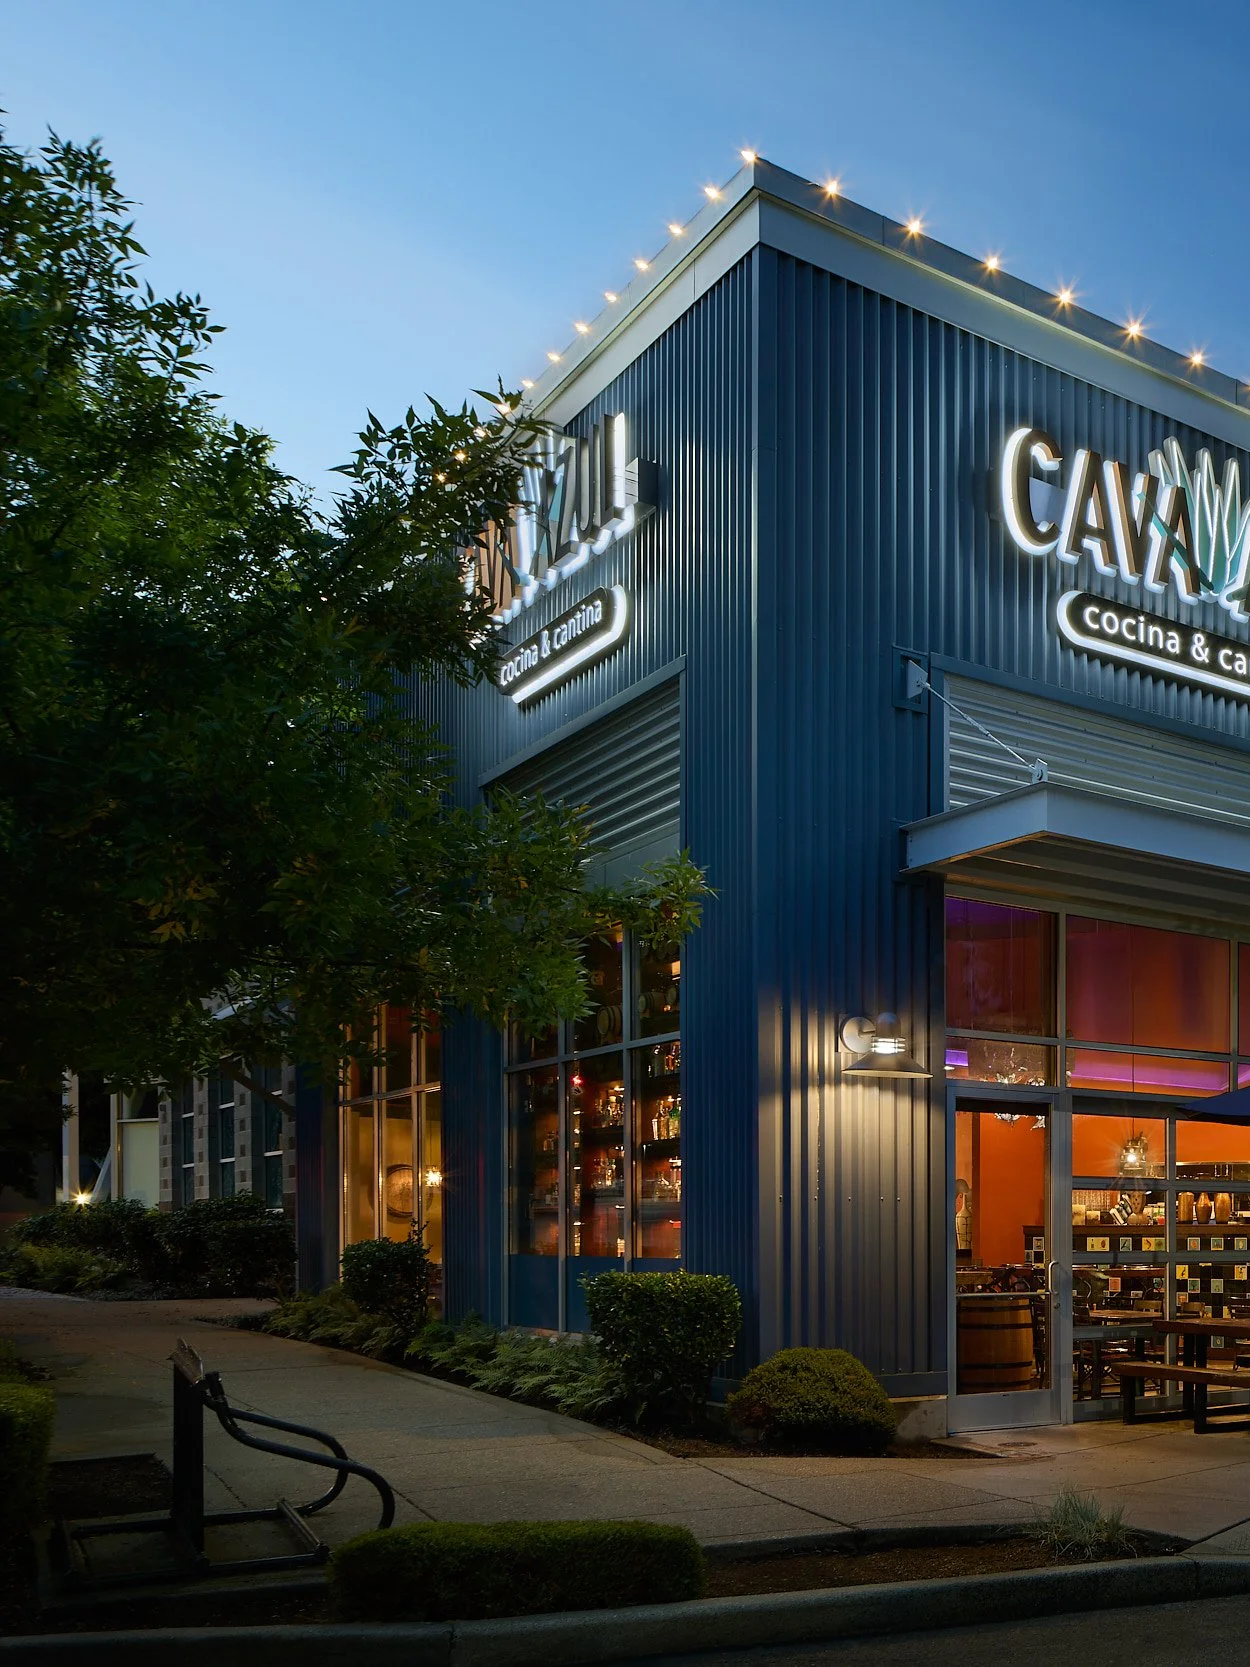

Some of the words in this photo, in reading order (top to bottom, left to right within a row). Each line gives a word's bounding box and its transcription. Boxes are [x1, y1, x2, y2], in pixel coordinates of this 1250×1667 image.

[1002, 427, 1203, 605] CAVA
[500, 643, 538, 686] cocina
[541, 629, 551, 659] &
[552, 600, 602, 650] cantina
[1082, 603, 1181, 655] cocina
[1189, 632, 1210, 664] &
